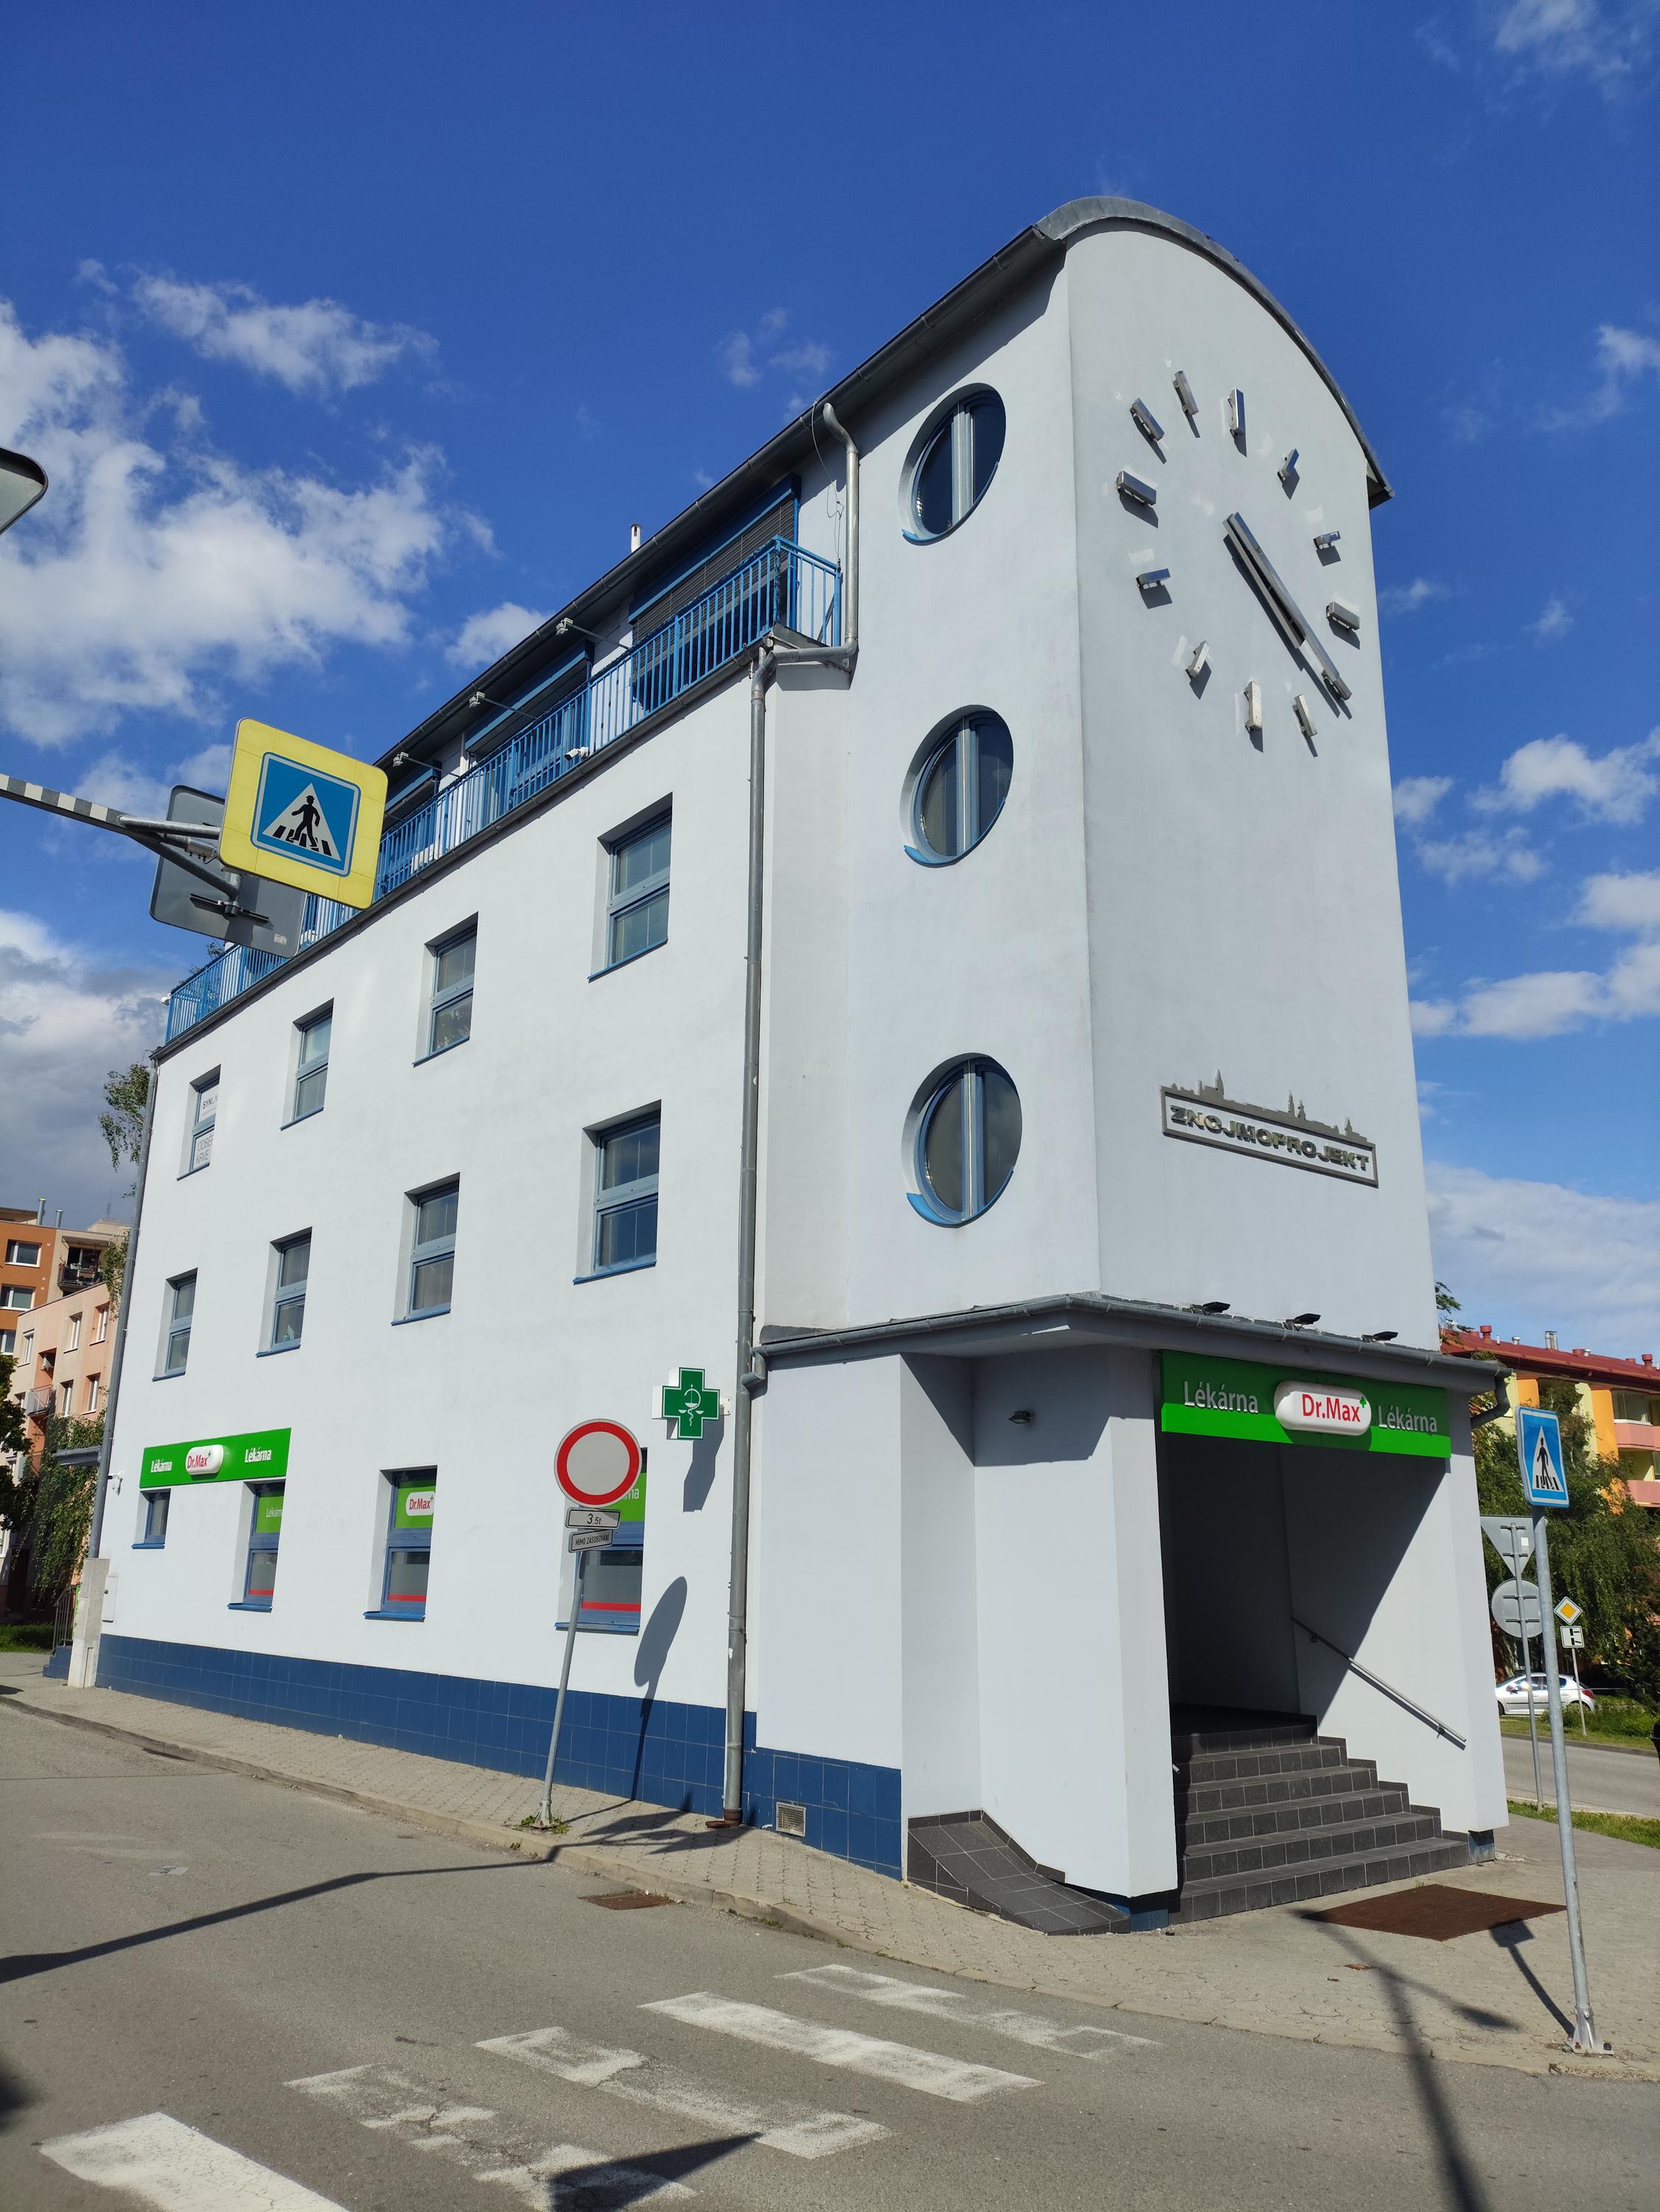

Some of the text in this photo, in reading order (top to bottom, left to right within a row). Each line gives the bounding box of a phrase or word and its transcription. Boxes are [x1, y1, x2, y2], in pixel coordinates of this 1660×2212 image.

[1170, 1105, 1369, 1171] ZNOJMOPROJEKT
[1183, 1381, 1437, 1433] Lékárna Dr.Max Lékárna
[150, 1447, 271, 1473] Lékárna Dr.Max Lékárna
[409, 1498, 430, 1510] Dr.Max
[575, 1537, 586, 1546] MIMO
